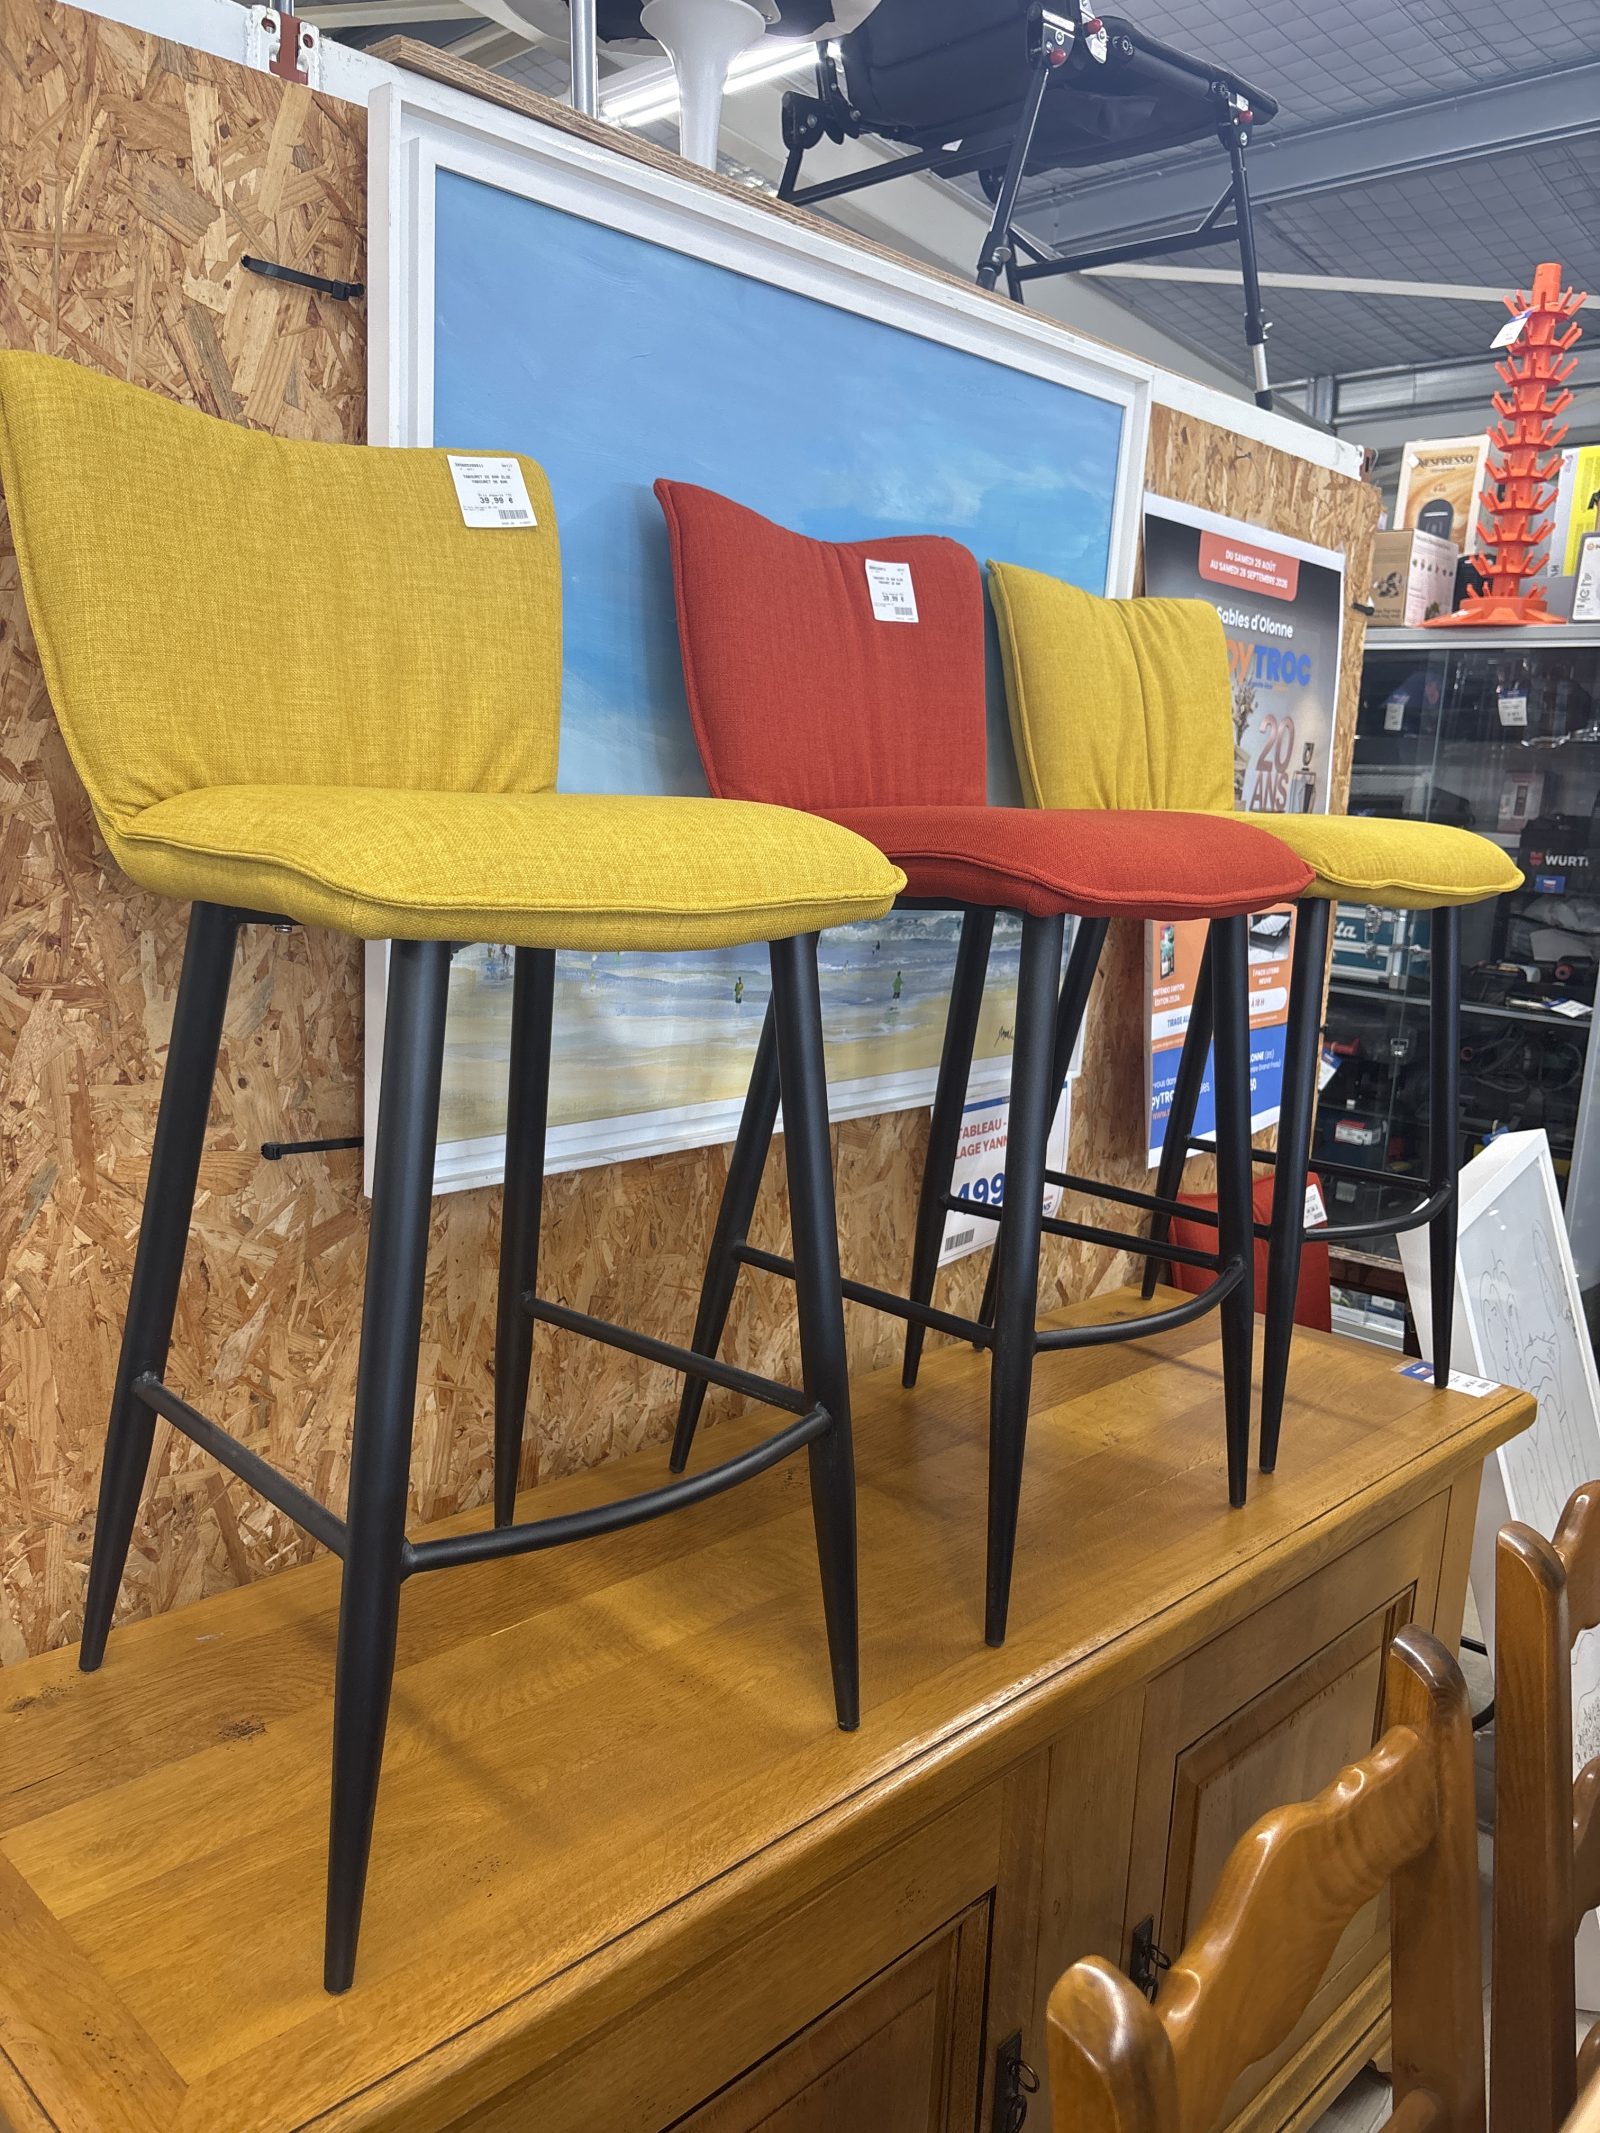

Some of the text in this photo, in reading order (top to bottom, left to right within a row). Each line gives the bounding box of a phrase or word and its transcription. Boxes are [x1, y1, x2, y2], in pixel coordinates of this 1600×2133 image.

[1418, 455, 1474, 468] NESPRESSO
[480, 497, 504, 505] 39,99
[1225, 549, 1234, 561] DU
[1234, 552, 1255, 566] SAMEDI
[1210, 559, 1219, 570] AU
[1219, 562, 1240, 576] SAMEDI
[1247, 569, 1276, 586] SEPTEMBRE
[1250, 613, 1293, 639] d'Olonne
[1256, 713, 1295, 774] 20
[1248, 771, 1289, 814] ANS
[1335, 920, 1357, 939] ta
[1168, 1015, 1182, 1028] TIRAGE
[1250, 1051, 1264, 1063] ONNE
